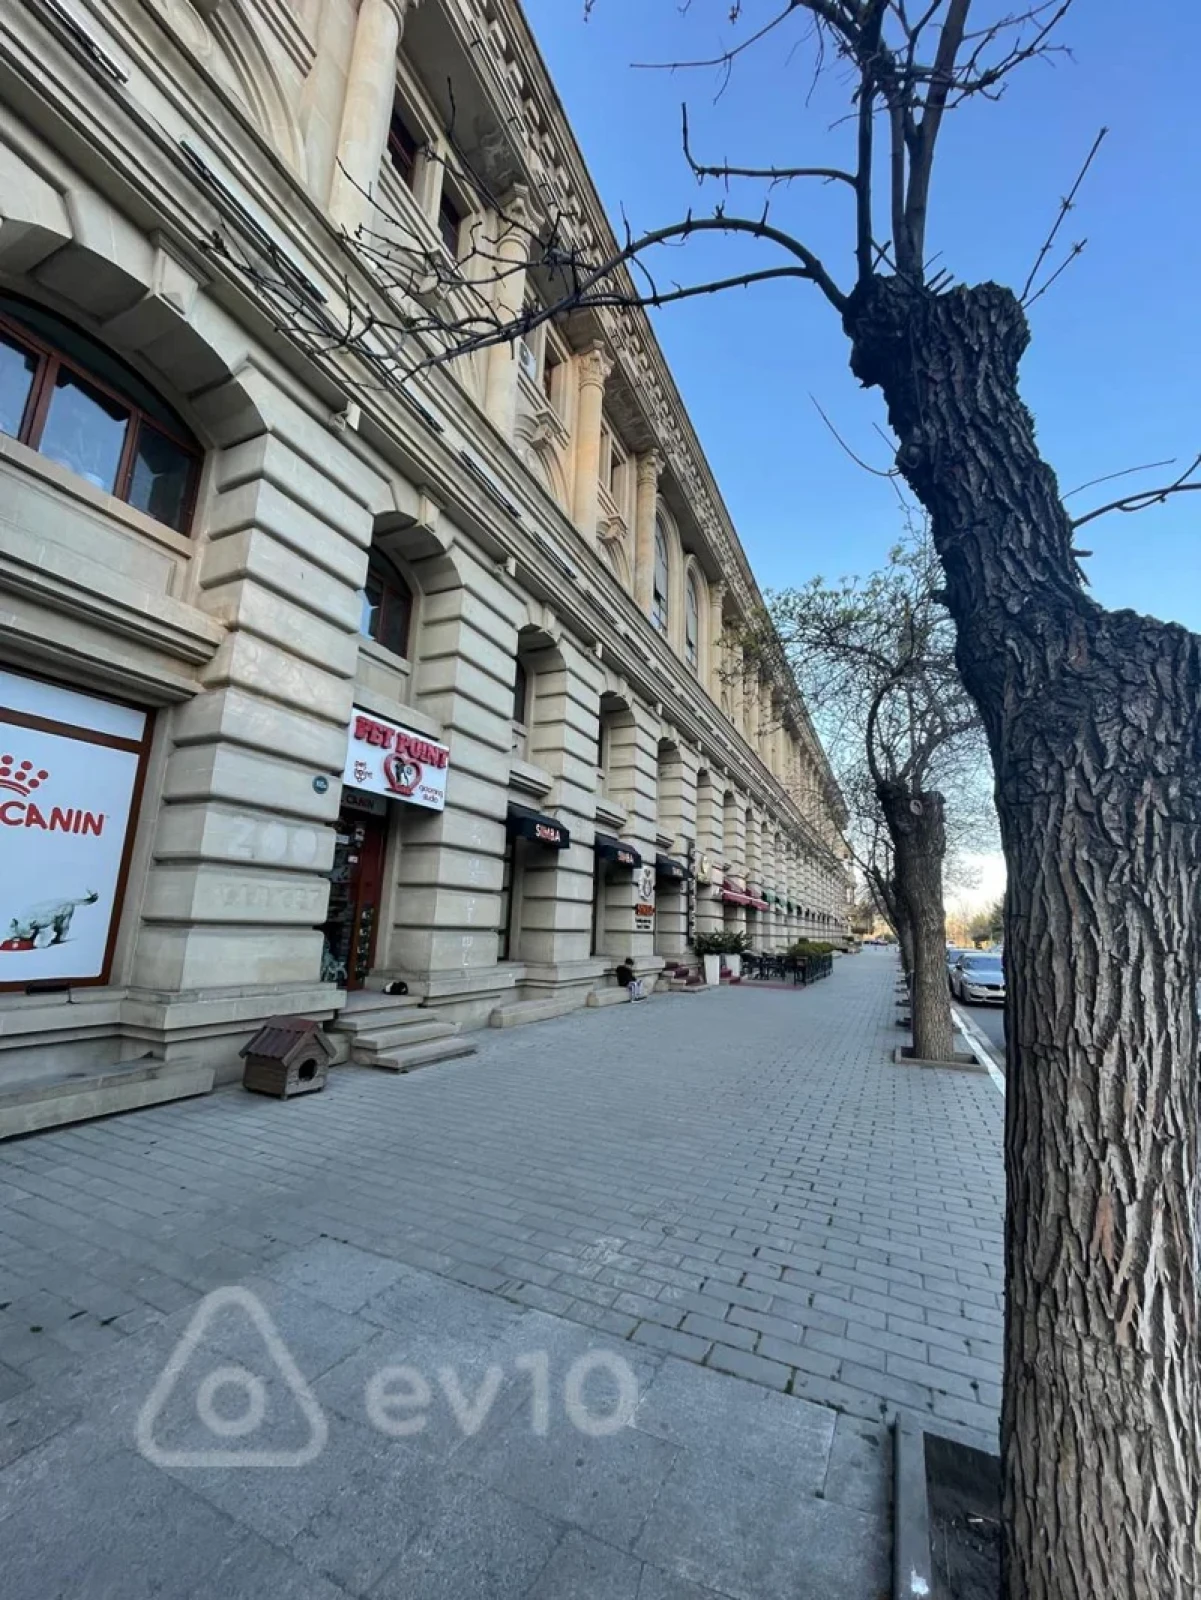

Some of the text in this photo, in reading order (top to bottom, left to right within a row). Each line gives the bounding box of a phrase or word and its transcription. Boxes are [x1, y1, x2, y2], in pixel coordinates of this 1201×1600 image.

[355, 716, 449, 768] PET POINT
[0, 801, 104, 836] CANIN
